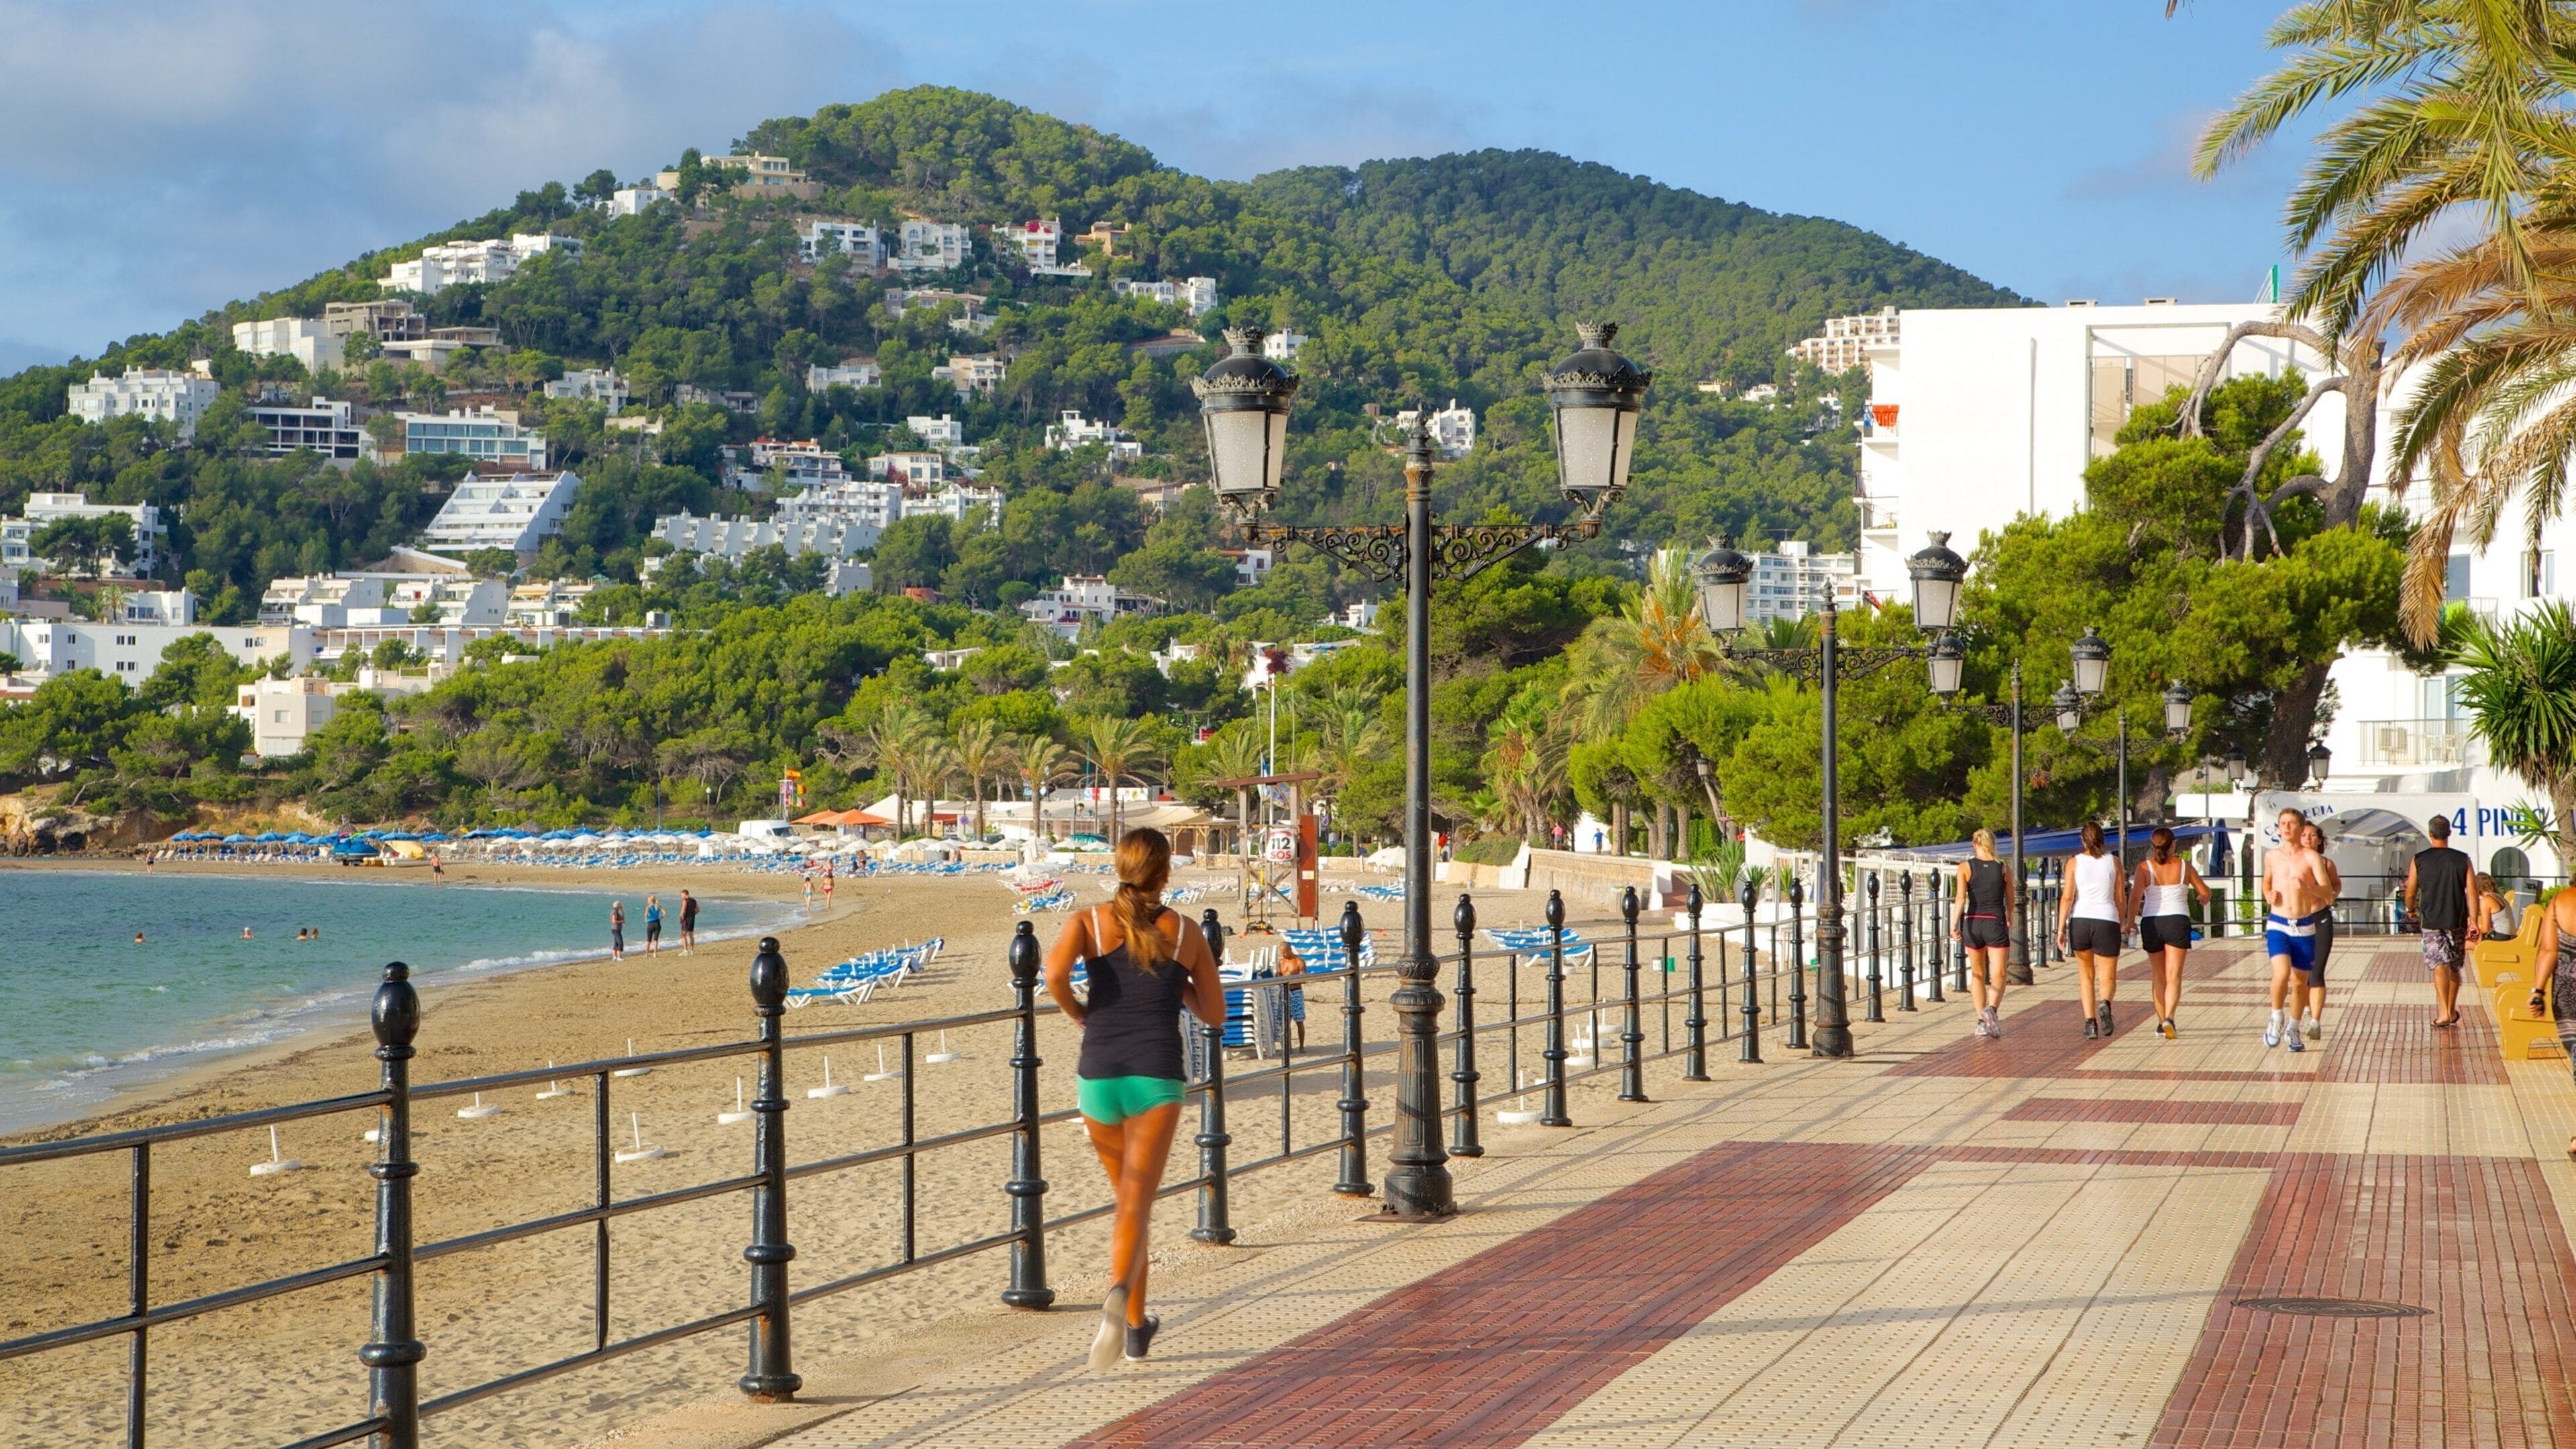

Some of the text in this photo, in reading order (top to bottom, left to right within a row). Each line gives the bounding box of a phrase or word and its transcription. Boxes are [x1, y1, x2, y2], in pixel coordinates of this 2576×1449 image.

[2451, 808, 2467, 836] 4
[1271, 837, 1291, 849] 112
[1271, 851, 1291, 859] SOS
